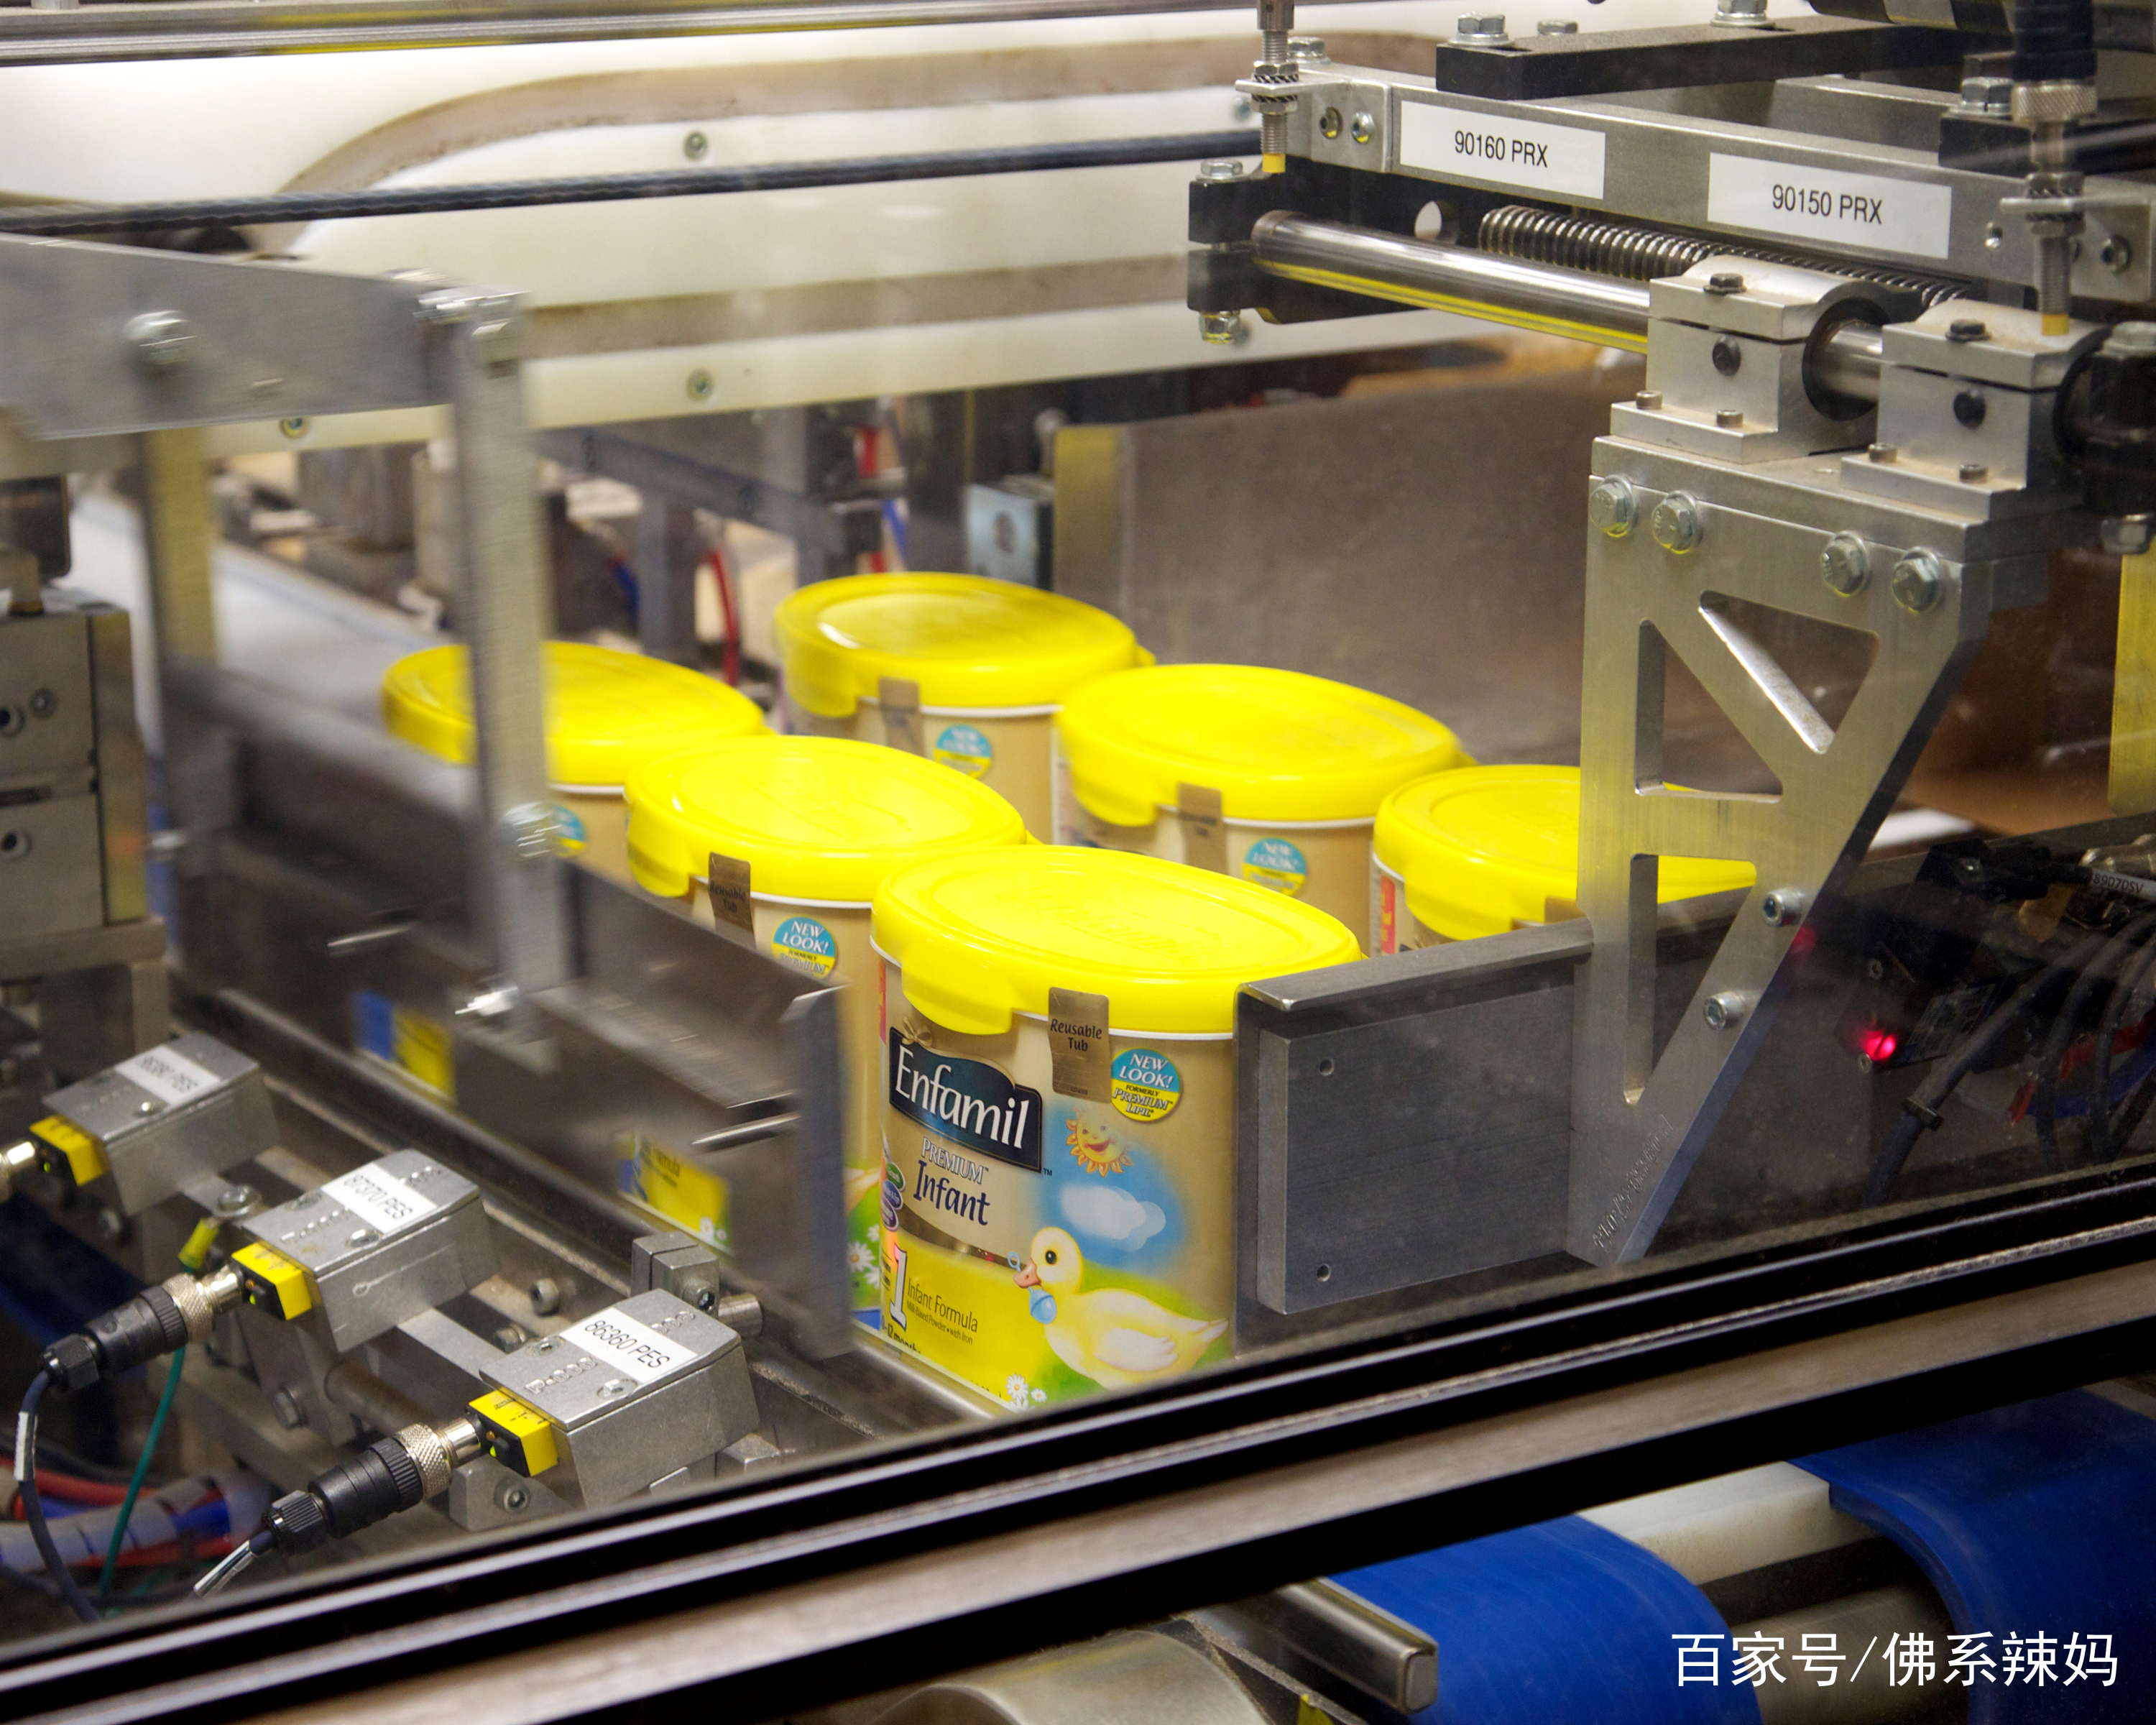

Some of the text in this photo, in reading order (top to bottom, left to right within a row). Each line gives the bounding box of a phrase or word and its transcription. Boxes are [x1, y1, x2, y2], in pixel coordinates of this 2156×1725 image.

[1455, 129, 1548, 168] 90160 PRX
[1772, 184, 1883, 225] 90150 PRX
[709, 879, 747, 902] Reusable
[723, 898, 738, 913] Tub
[791, 920, 824, 938] NEW
[783, 932, 831, 954] LOOK!
[1050, 1018, 1103, 1039] Reusable
[1068, 1037, 1089, 1052] Tub
[1130, 1054, 1169, 1072] NEW
[1119, 1065, 1174, 1089] LOOK!
[895, 1044, 1030, 1149] Enfamil
[1125, 1084, 1160, 1097] FORMERLY
[913, 1159, 990, 1226] Infant
[377, 1196, 413, 1220] PES
[890, 1242, 908, 1333] 1
[907, 1277, 978, 1333] Infant Formula
[584, 1320, 637, 1350] 86360
[627, 1344, 671, 1368] PES
[961, 1331, 973, 1346] Iron
